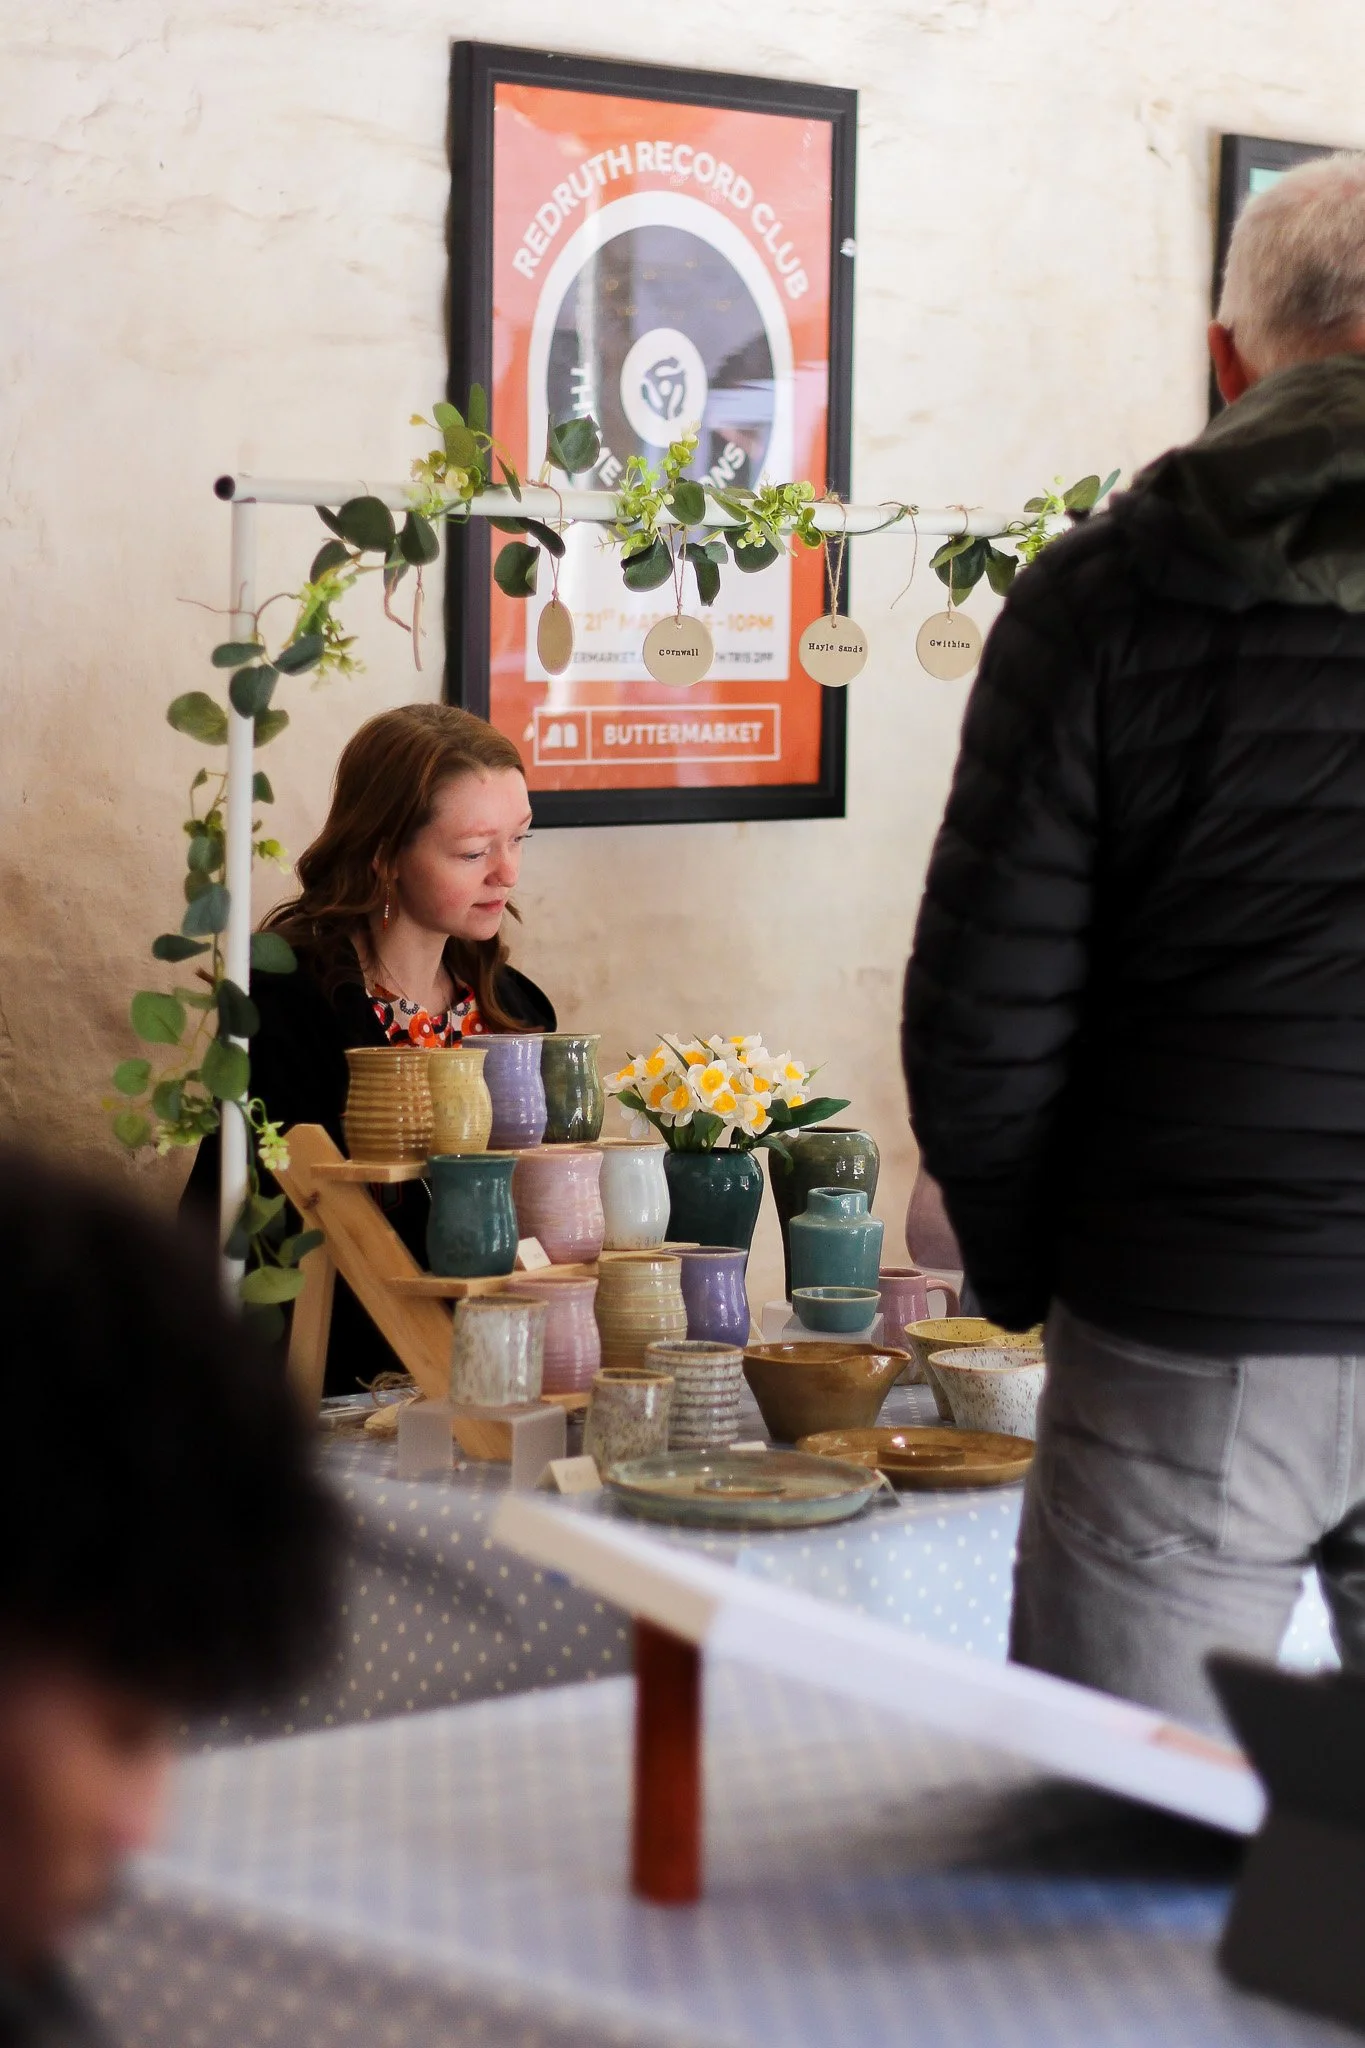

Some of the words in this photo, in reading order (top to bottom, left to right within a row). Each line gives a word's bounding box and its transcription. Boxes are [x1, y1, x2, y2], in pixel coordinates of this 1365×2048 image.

[512, 144, 633, 280] REDRUTH
[635, 140, 754, 209] RECORD
[751, 203, 810, 300] CLUB
[808, 642, 834, 652] Hayle
[838, 644, 863, 653] Sands
[929, 639, 971, 649] Gwithian
[658, 648, 699, 657] Cornwall
[602, 721, 763, 746] BUTTERMARKET
